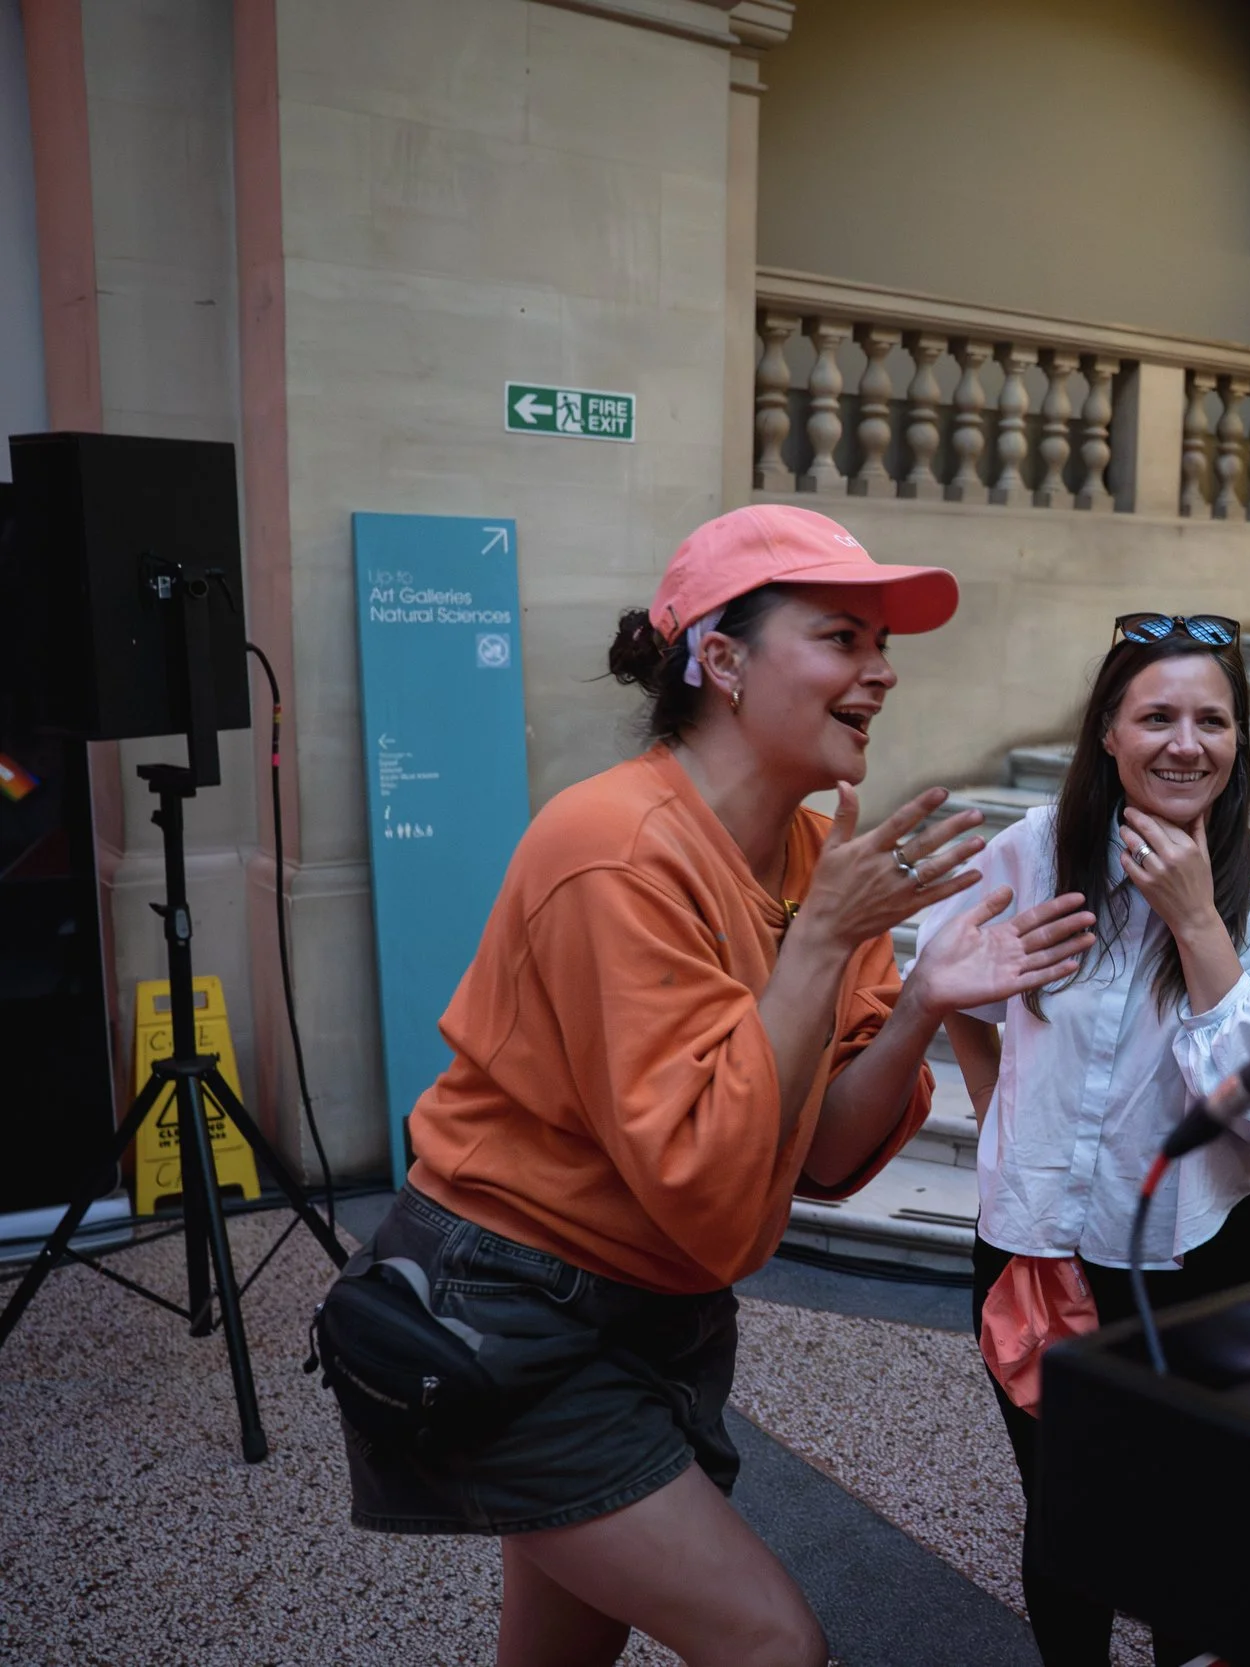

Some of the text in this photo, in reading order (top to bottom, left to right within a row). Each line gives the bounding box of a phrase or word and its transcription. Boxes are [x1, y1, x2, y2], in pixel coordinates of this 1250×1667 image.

[588, 398, 628, 418] FIRE
[588, 415, 628, 434] EXIT
[367, 569, 414, 588] Up to
[369, 586, 473, 605] Art Galleries
[370, 606, 512, 624] Natural Sciences
